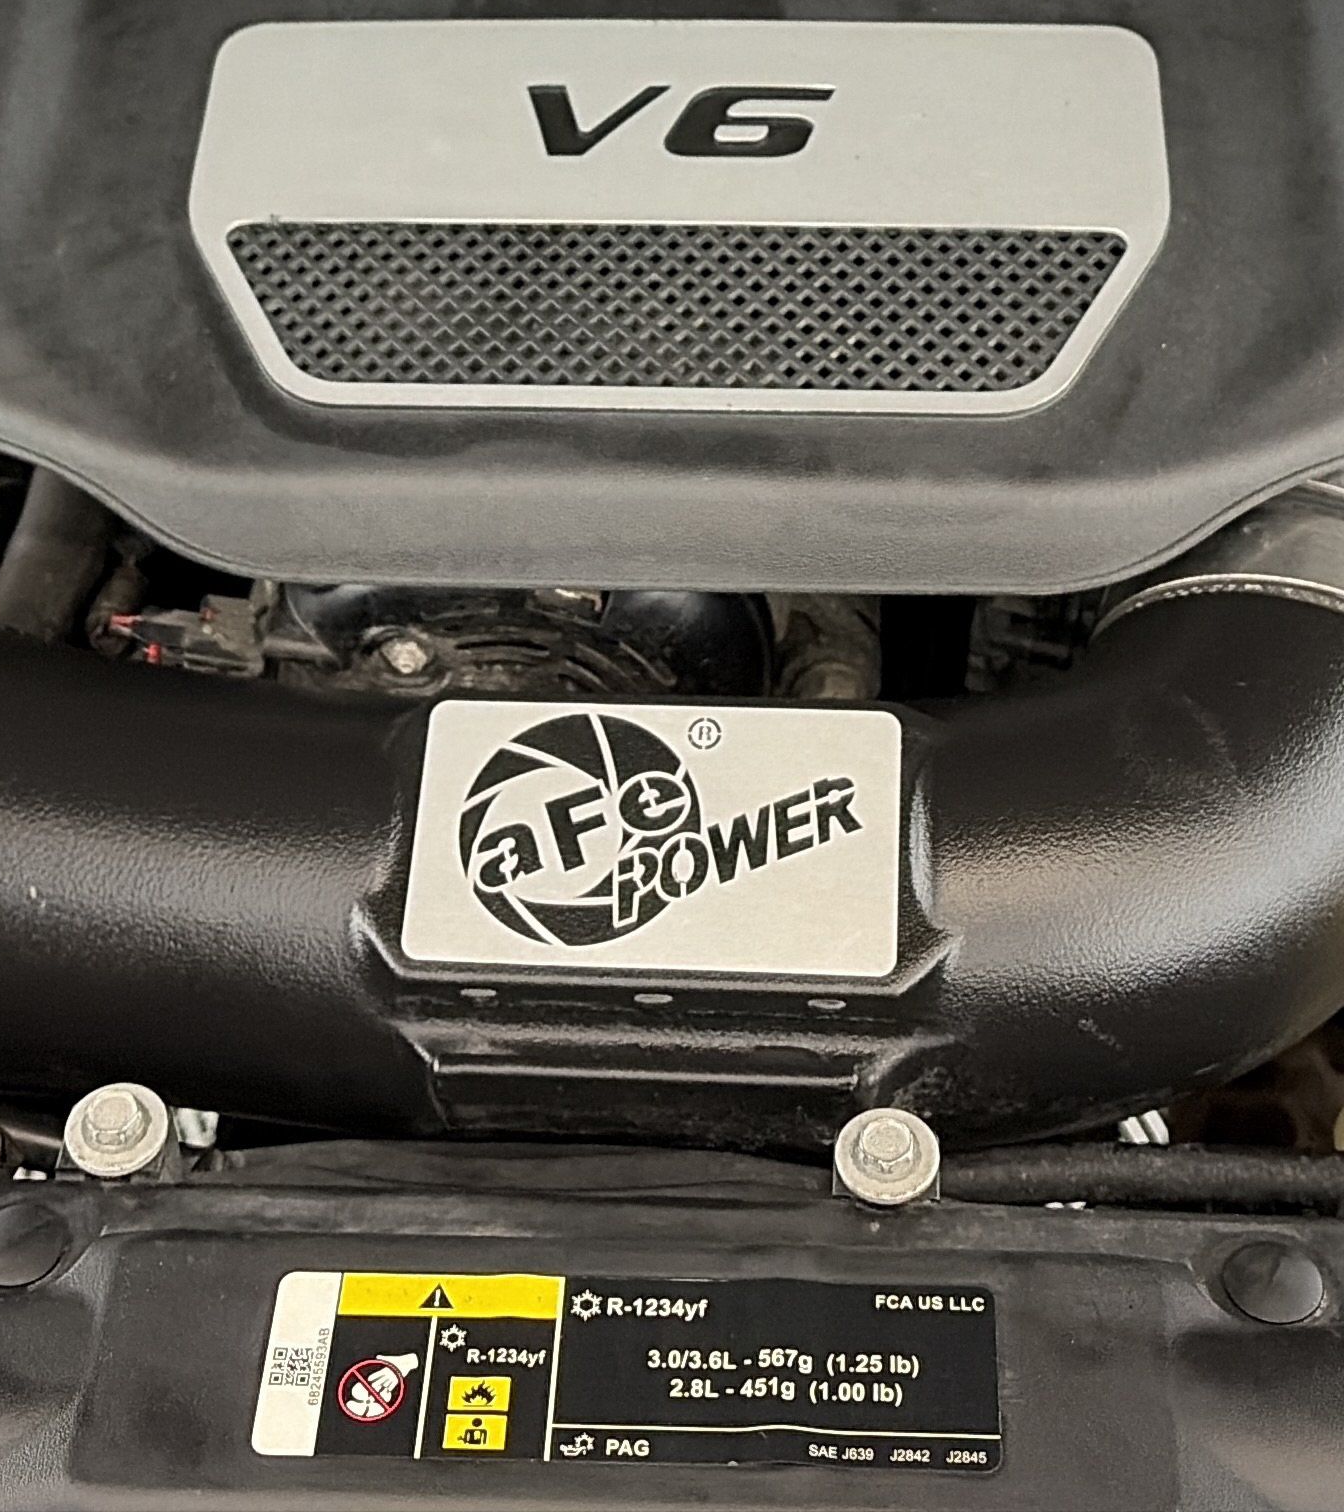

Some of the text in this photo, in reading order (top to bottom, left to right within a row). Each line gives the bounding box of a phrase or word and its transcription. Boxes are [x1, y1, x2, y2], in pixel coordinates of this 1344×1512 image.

[526, 82, 837, 158] V6
[612, 776, 864, 928] POWER
[606, 1297, 709, 1322] R-1234yf
[875, 1294, 985, 1312] FCA US LLC
[467, 1349, 547, 1369] R-1234yf
[647, 1349, 738, 1370] 3.0/3.6L
[758, 1348, 813, 1374] 567g
[826, 1353, 883, 1377] (1.25
[890, 1354, 920, 1379] lb)
[669, 1378, 720, 1398] 2.8L
[739, 1376, 796, 1401] 451g
[809, 1380, 866, 1404] (1.00
[872, 1382, 903, 1407] lb)
[605, 1439, 650, 1457] PAG
[808, 1444, 988, 1464] SAE J639 J2842 J2845
